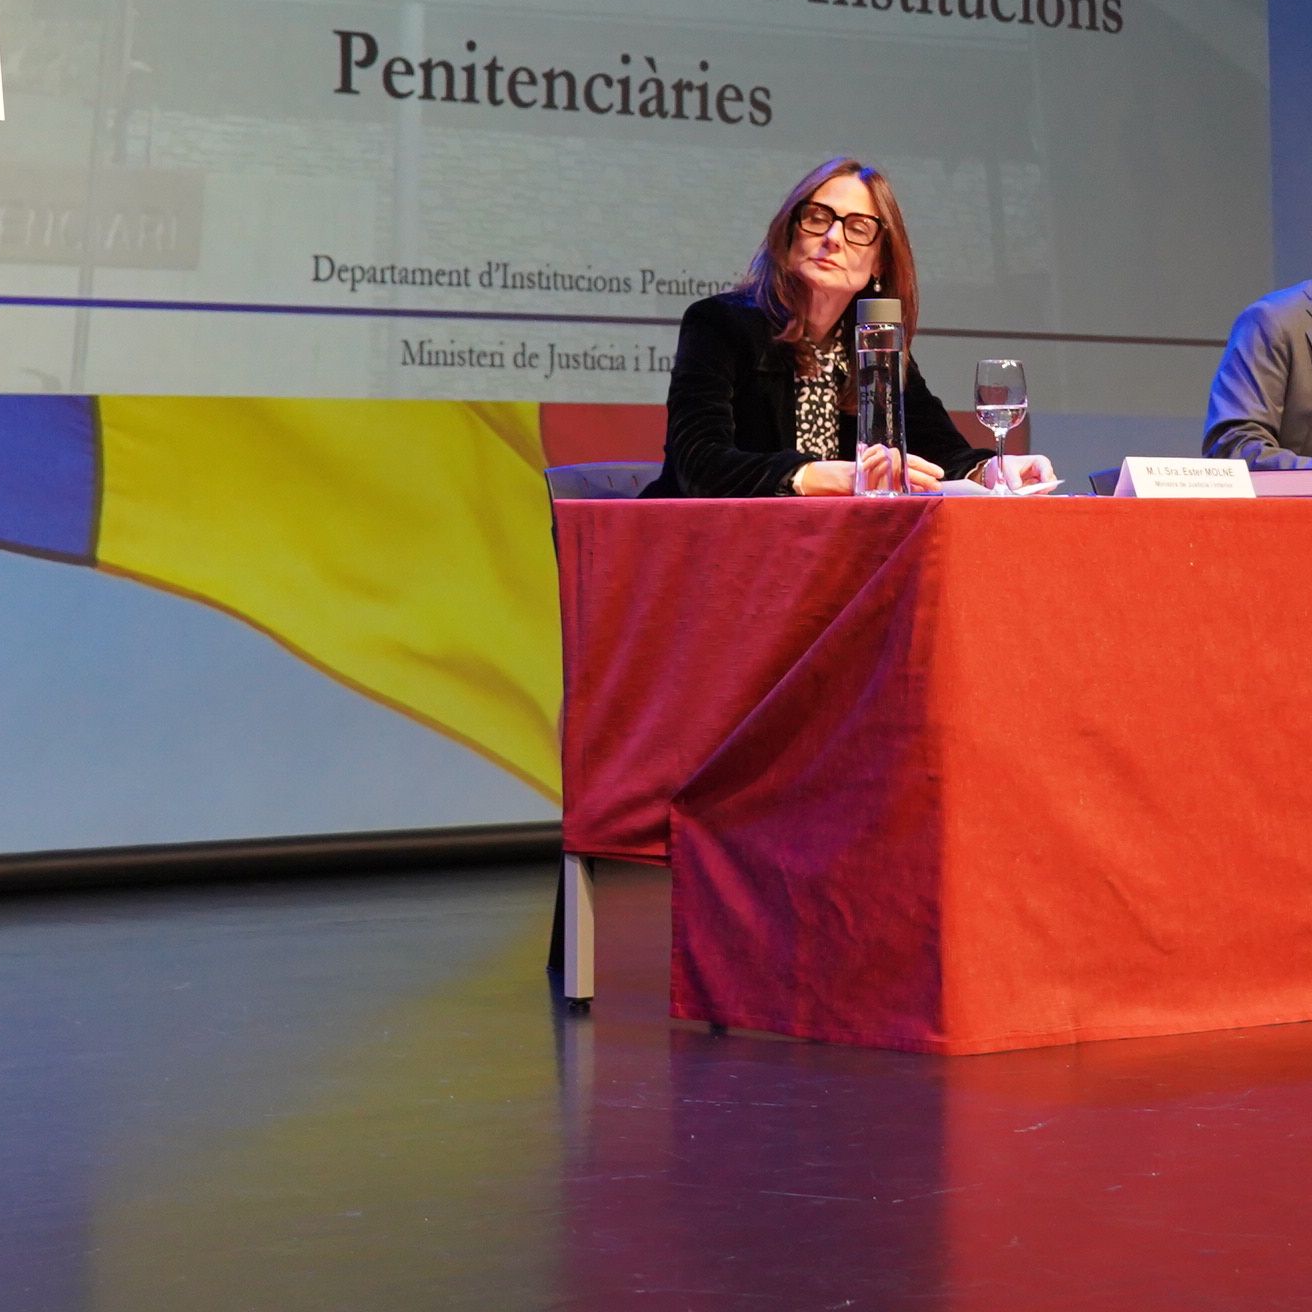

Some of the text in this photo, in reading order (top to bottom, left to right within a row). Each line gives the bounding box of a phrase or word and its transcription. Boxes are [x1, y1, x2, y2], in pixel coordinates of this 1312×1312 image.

[332, 29, 772, 128] Penitenciàries
[311, 254, 472, 291] Departament
[478, 261, 633, 295] d'Institucions
[400, 339, 677, 380] Ministeri de Justícia i In
